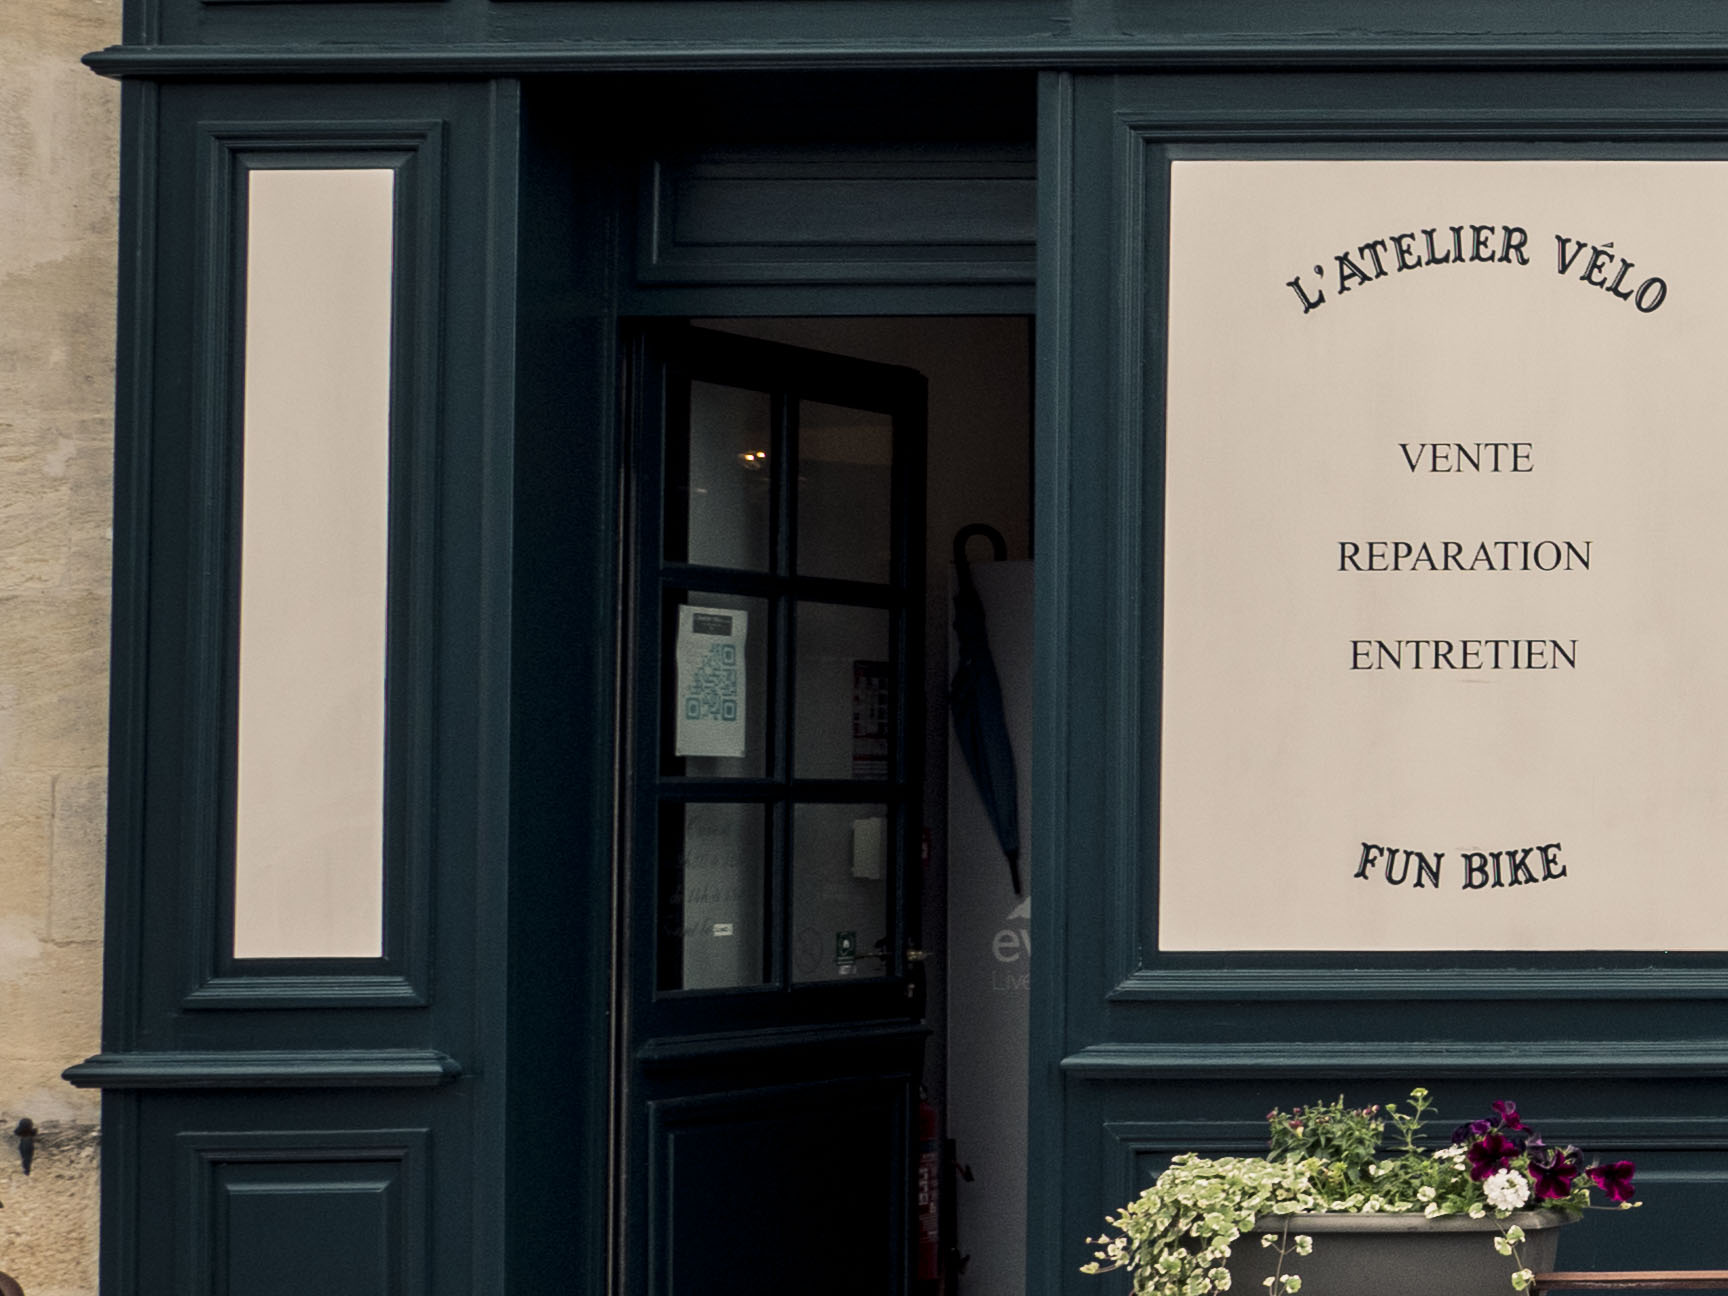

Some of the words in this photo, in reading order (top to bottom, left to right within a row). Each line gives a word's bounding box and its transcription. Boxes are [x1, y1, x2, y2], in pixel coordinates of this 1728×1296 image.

[1285, 224, 1530, 315] L'ATELIER
[1554, 234, 1668, 314] VÉLO
[1398, 442, 1534, 473] VENTE
[1337, 540, 1592, 572] REPARATION
[1350, 639, 1578, 670] ENTRETIEN
[1353, 841, 1446, 889] FUN
[1460, 842, 1568, 891] BIKE
